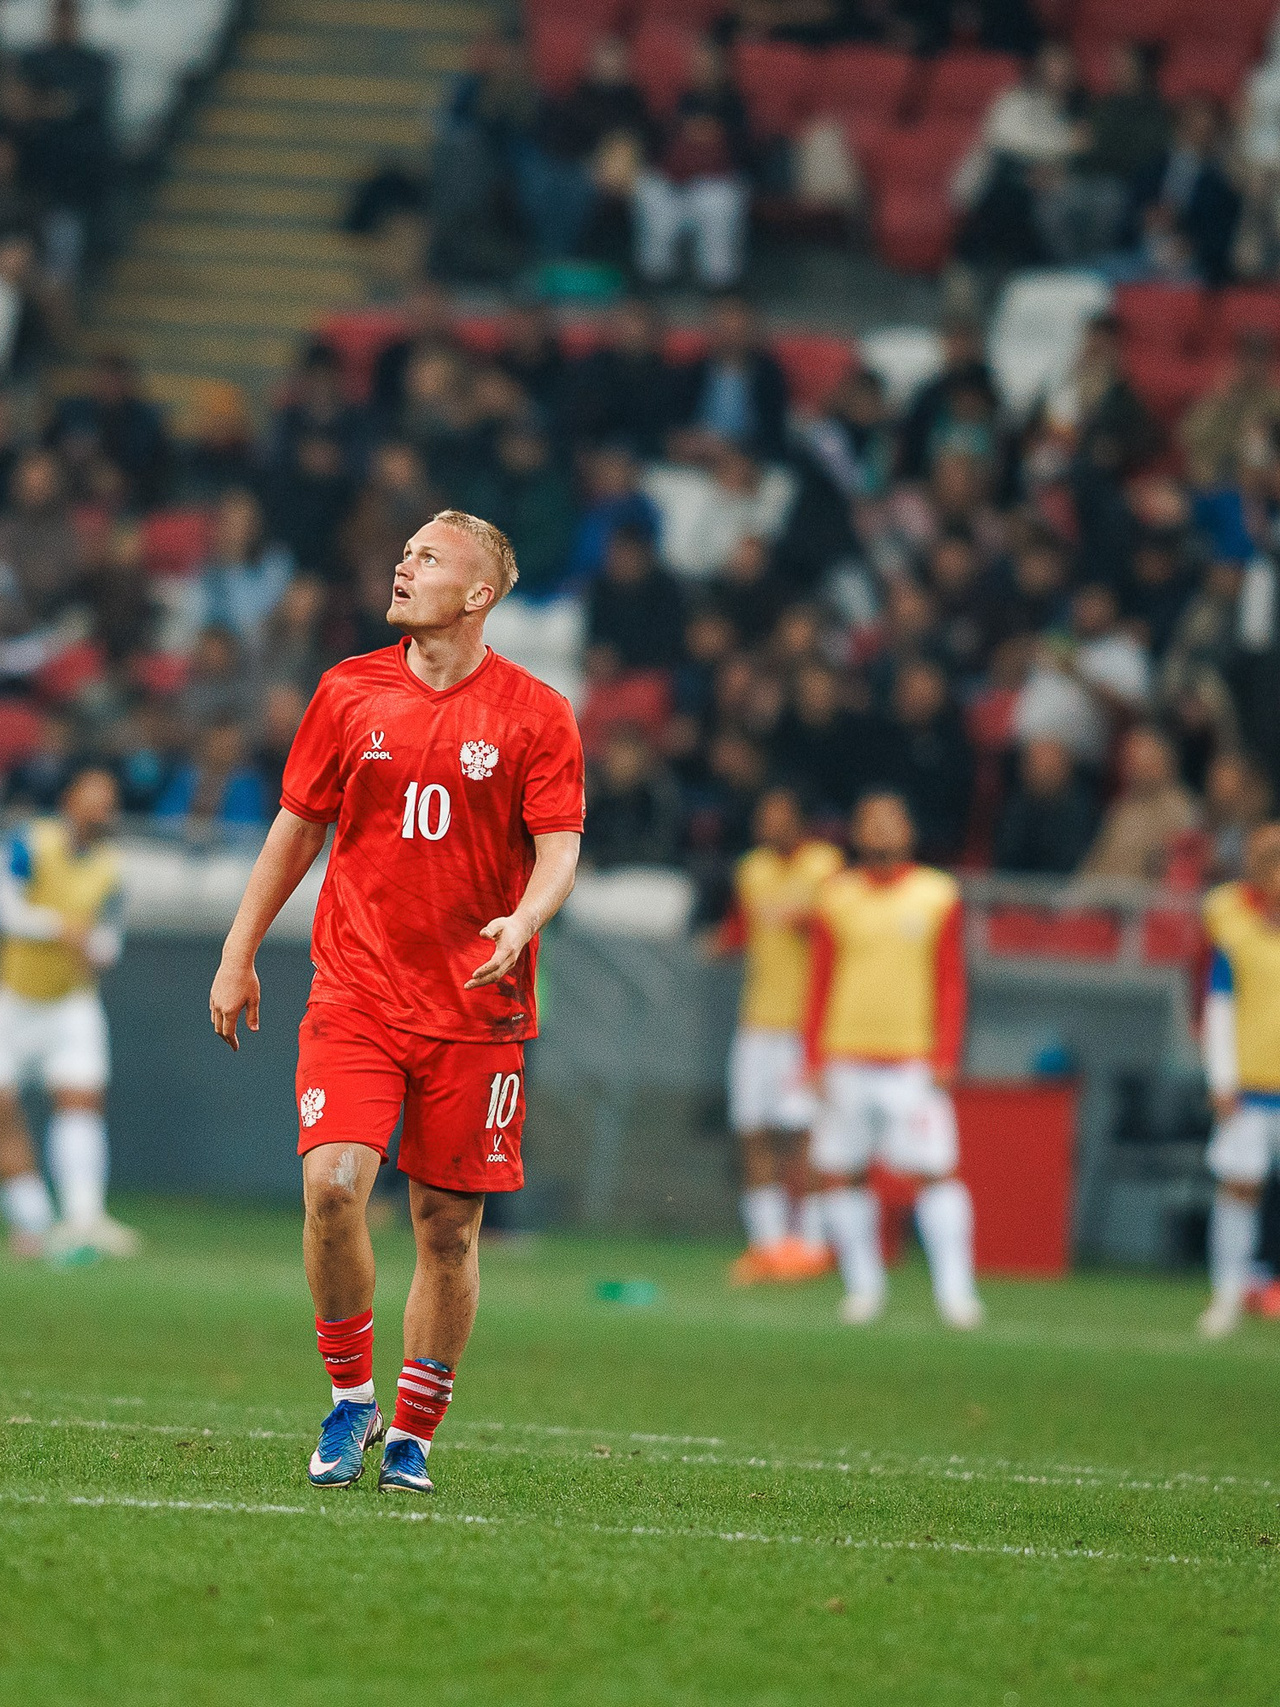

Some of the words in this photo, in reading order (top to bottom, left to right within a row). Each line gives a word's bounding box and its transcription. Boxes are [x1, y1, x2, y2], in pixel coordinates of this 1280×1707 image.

[361, 751, 393, 760] JOGEL
[402, 781, 452, 841] 10
[485, 1072, 520, 1129] 10
